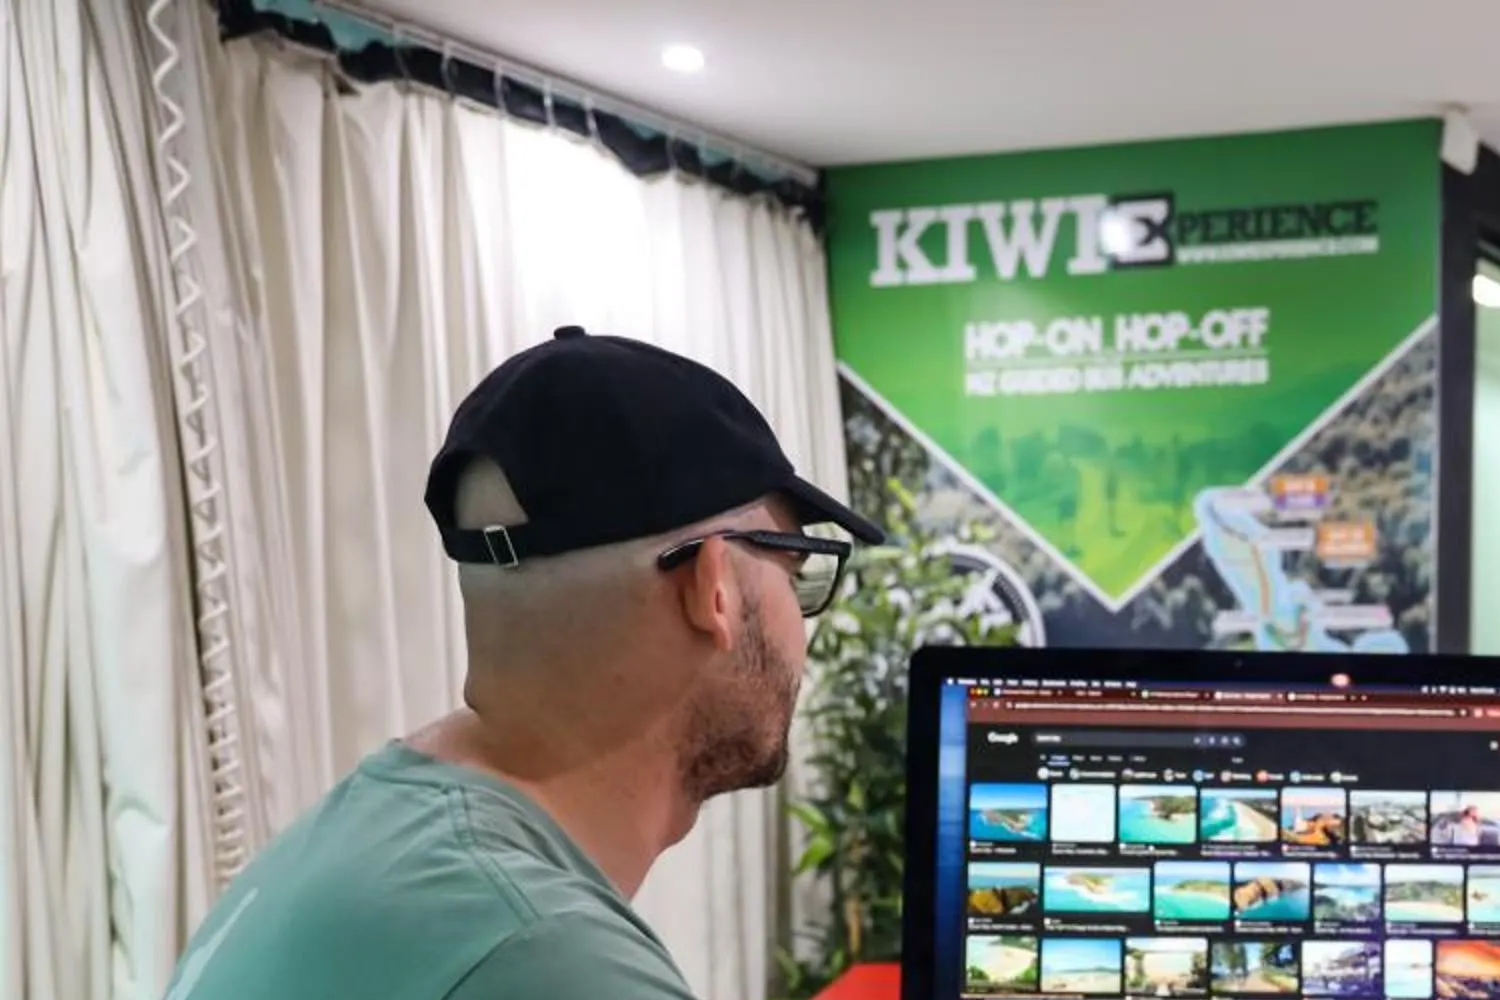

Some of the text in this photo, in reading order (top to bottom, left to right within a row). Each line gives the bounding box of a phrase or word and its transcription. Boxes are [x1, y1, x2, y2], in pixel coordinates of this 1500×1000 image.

[869, 195, 1107, 287] KIWI
[964, 308, 1269, 360] HOP-ON HOP-OFF
